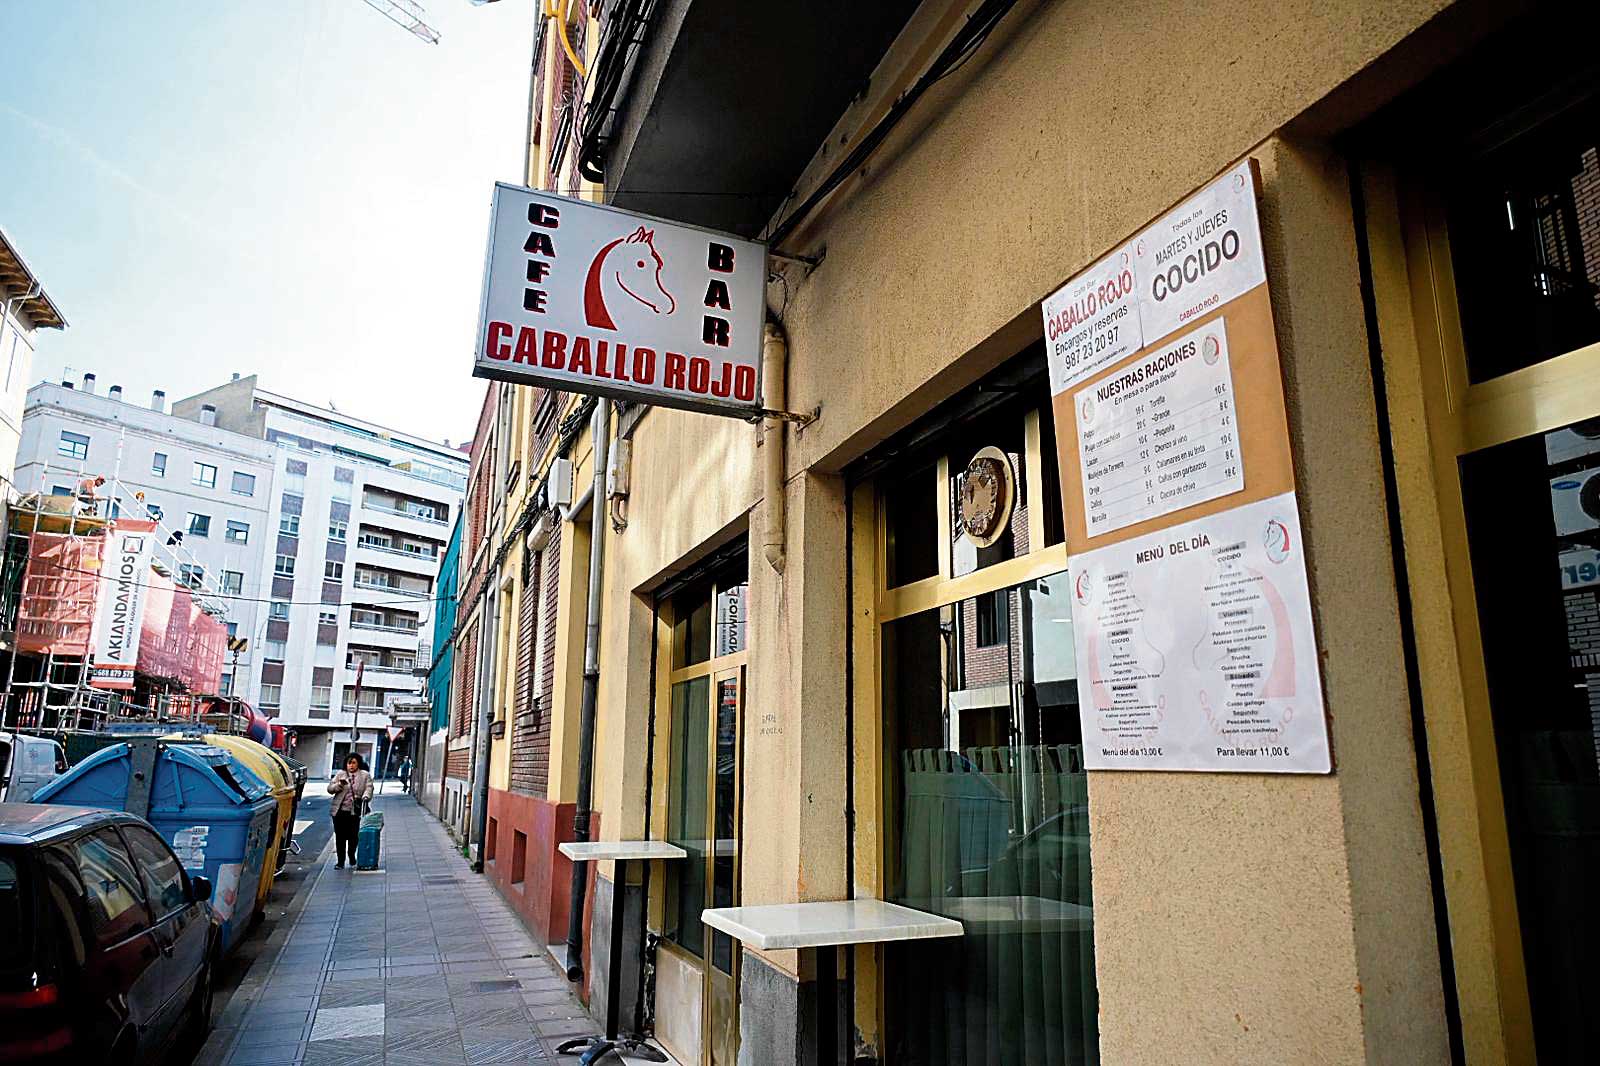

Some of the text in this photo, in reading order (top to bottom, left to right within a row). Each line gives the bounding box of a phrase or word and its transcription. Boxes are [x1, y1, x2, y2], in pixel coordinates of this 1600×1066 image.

[523, 203, 560, 314] CAFE
[1155, 209, 1228, 266] MARTES Y JUEVES
[1152, 229, 1240, 302] COCIDO
[702, 242, 736, 347] BAR
[1048, 270, 1132, 341] CABALLO ROJO
[1179, 294, 1219, 322] CABALLO ROJO
[1055, 304, 1128, 356] Encargos y reservas
[1065, 348, 1080, 370] 987
[1082, 341, 1093, 360] 23
[1094, 334, 1106, 353] 20
[1107, 325, 1118, 345] 97
[486, 320, 755, 401] CABALLO ROJO
[1097, 368, 1144, 403] NUESTRAS
[1145, 341, 1196, 378] RACIONES
[1114, 397, 1123, 405] En
[1123, 389, 1139, 401] mesa
[1145, 379, 1159, 392] para
[1160, 369, 1177, 383] llevar
[1214, 385, 1222, 394] 10
[1172, 470, 1181, 479] con
[1181, 452, 1187, 460] en
[1169, 540, 1190, 555] DEL
[1191, 533, 1210, 550] DÍA
[107, 556, 135, 660] AKIANDAMIOS
[1222, 610, 1248, 618] Viernes
[1119, 748, 1129, 756] del
[1158, 747, 1163, 756] €
[1216, 746, 1290, 757] Para llevar 11,00 €
